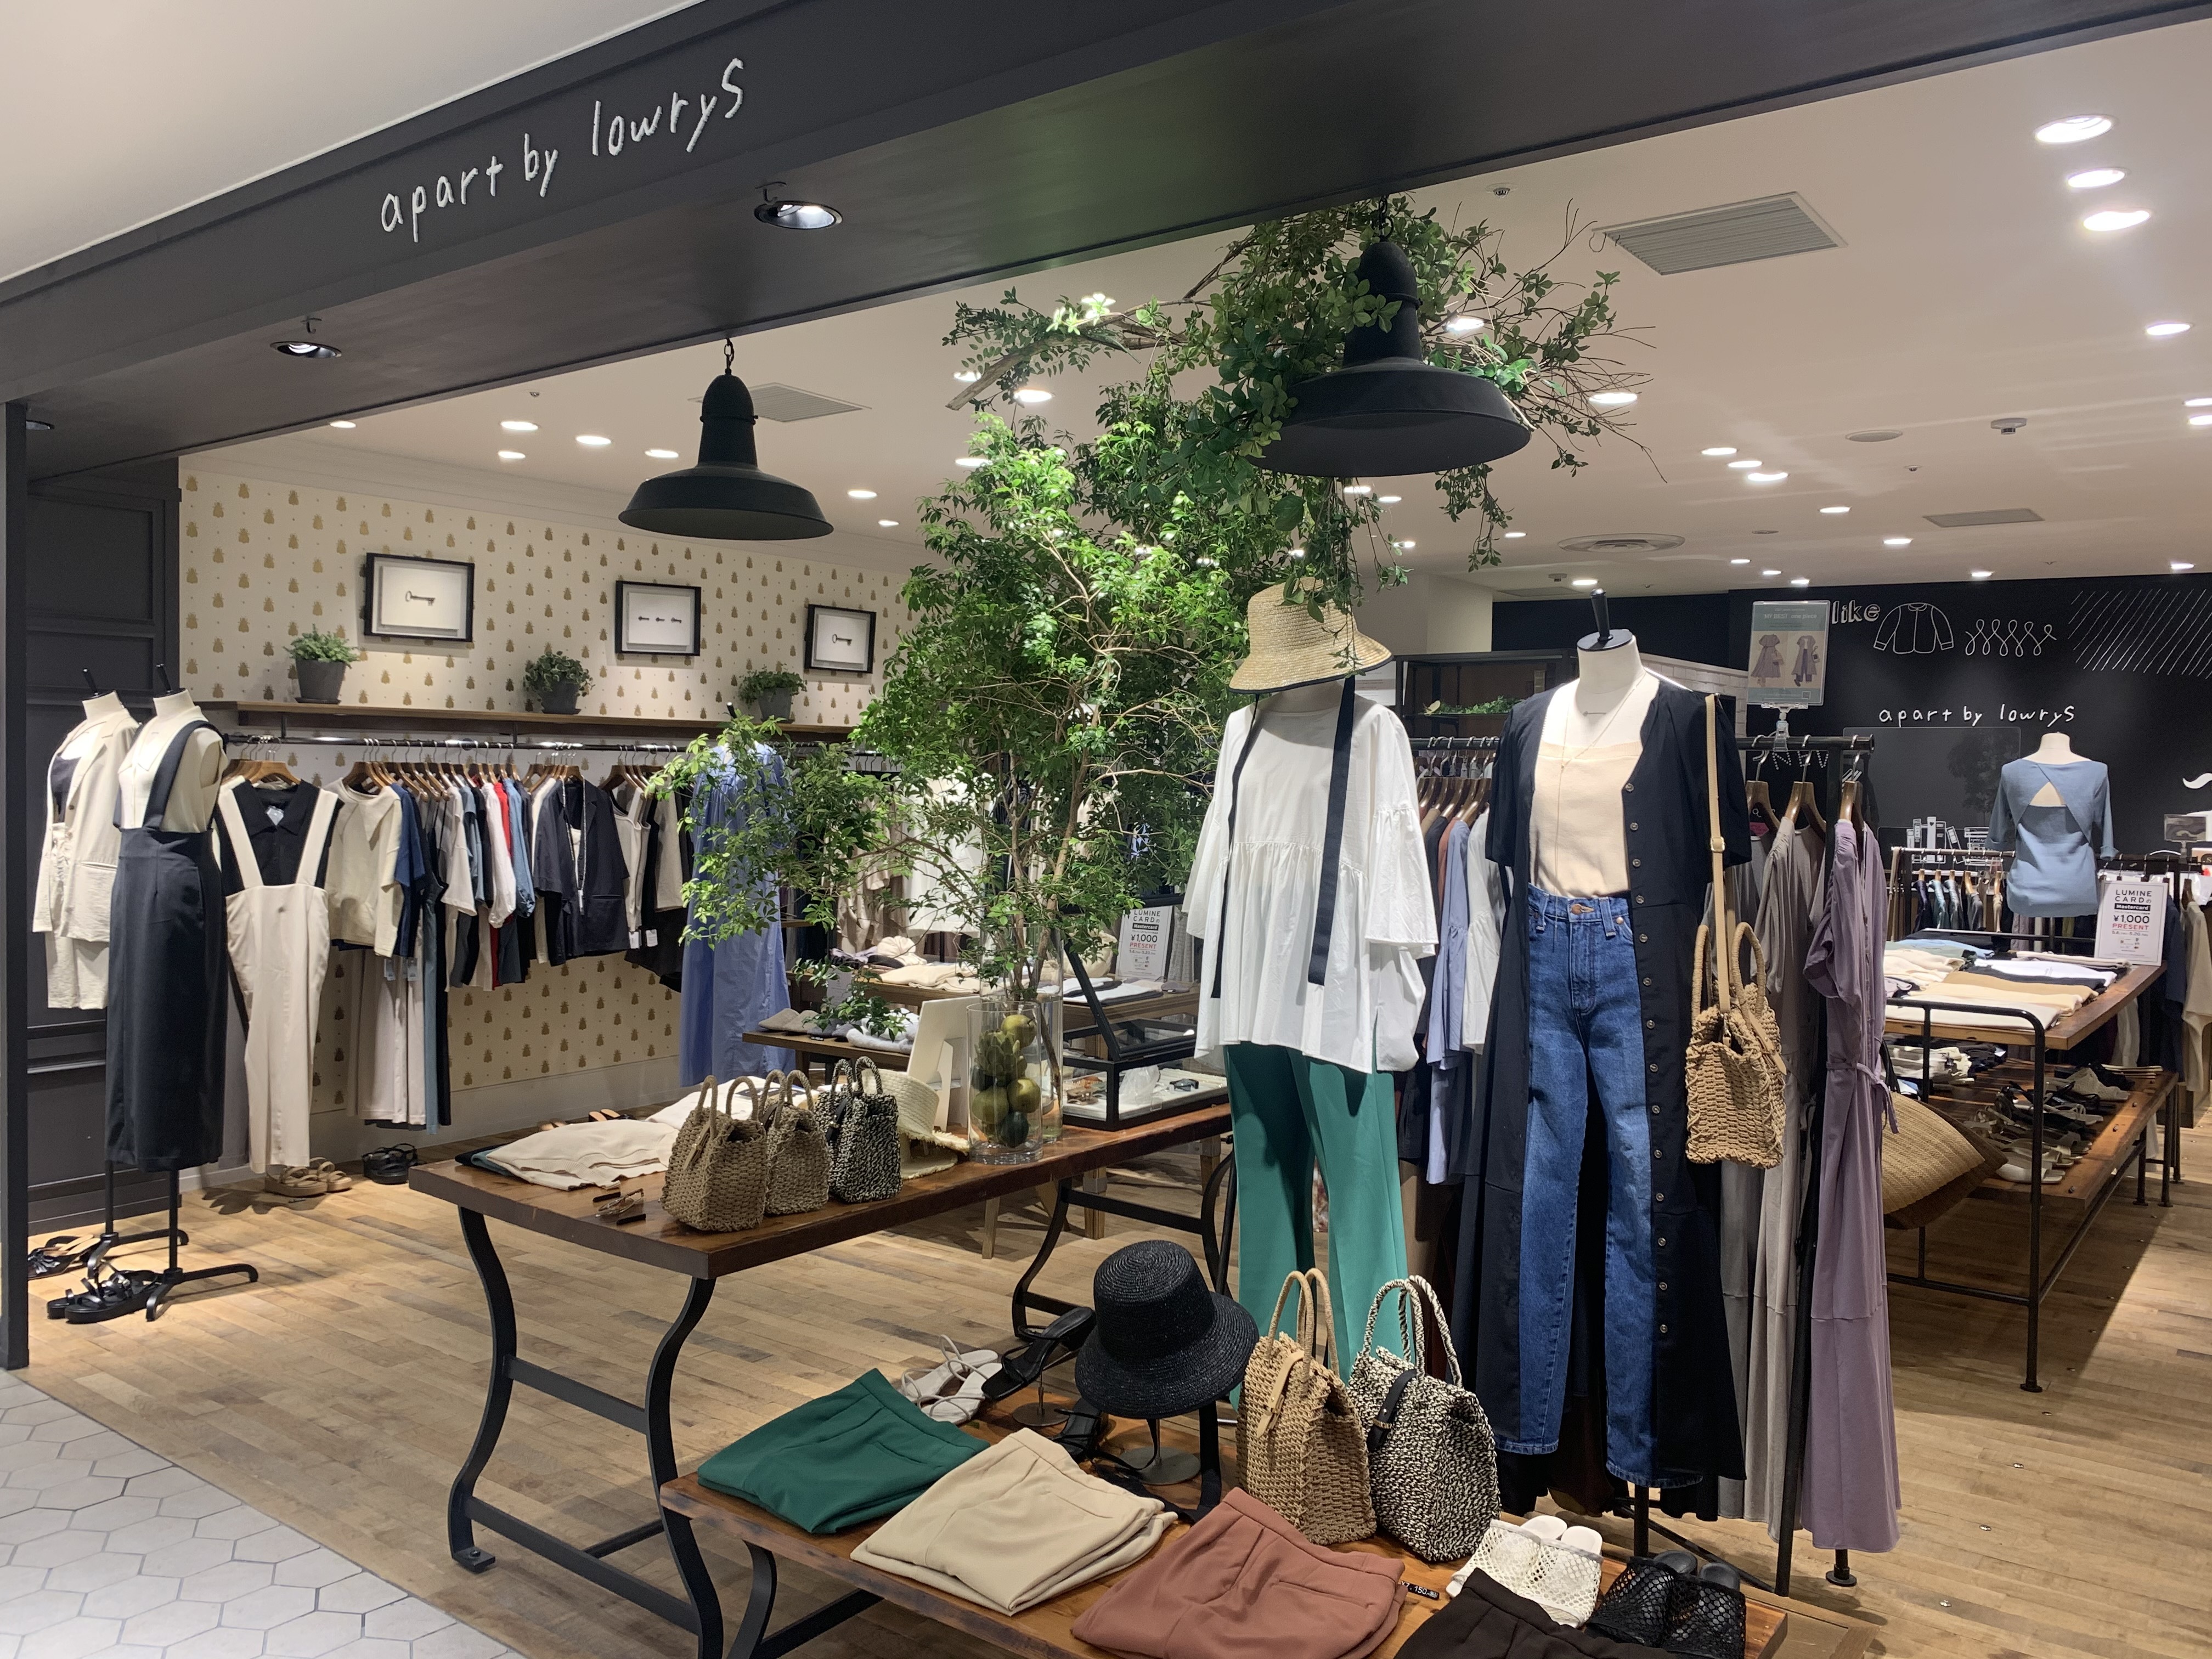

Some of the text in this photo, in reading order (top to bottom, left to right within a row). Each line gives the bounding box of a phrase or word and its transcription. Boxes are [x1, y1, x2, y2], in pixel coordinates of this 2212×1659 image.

[381, 155, 504, 242] apart
[524, 133, 558, 198] by
[1832, 600, 1881, 624] like
[1879, 708, 1952, 728] apart
[1963, 706, 1983, 727] by
[1134, 909, 1161, 917] LUMINE
[2113, 915, 2150, 924] ¥1,000
[1131, 934, 1158, 943] ¥1,000
